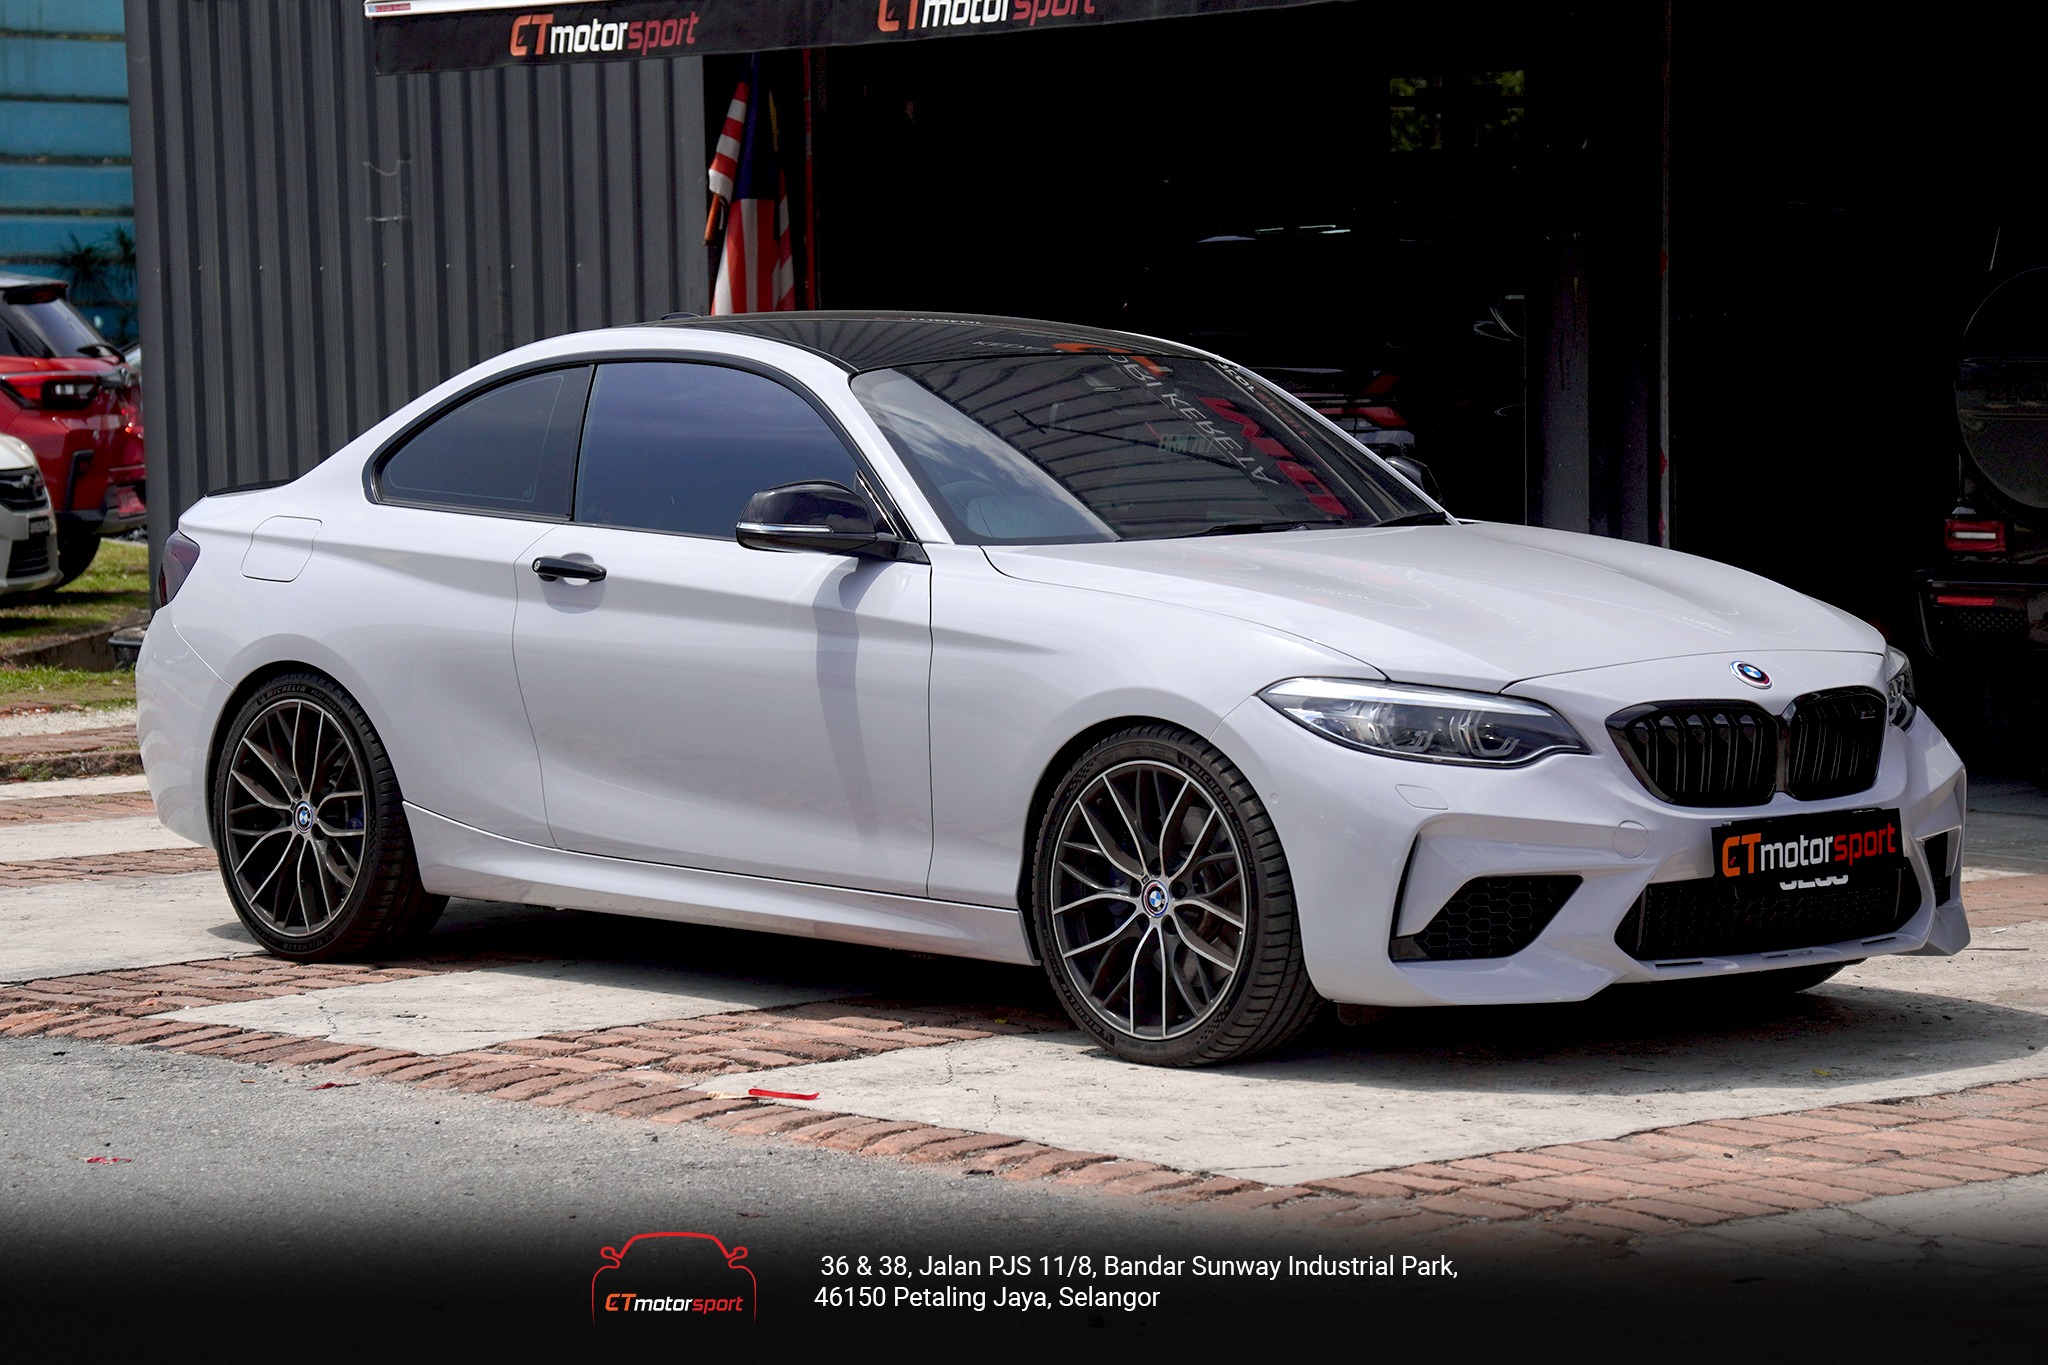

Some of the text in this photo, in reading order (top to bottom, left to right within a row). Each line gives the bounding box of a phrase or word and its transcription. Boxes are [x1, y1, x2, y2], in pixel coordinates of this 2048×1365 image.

[509, 11, 700, 57] CTmotorsport
[266, 684, 307, 699] MICHELIN
[1190, 762, 1235, 815] MICHELIN
[1722, 822, 1897, 878] CTmotorsport
[1059, 982, 1102, 1035] MICHELIN
